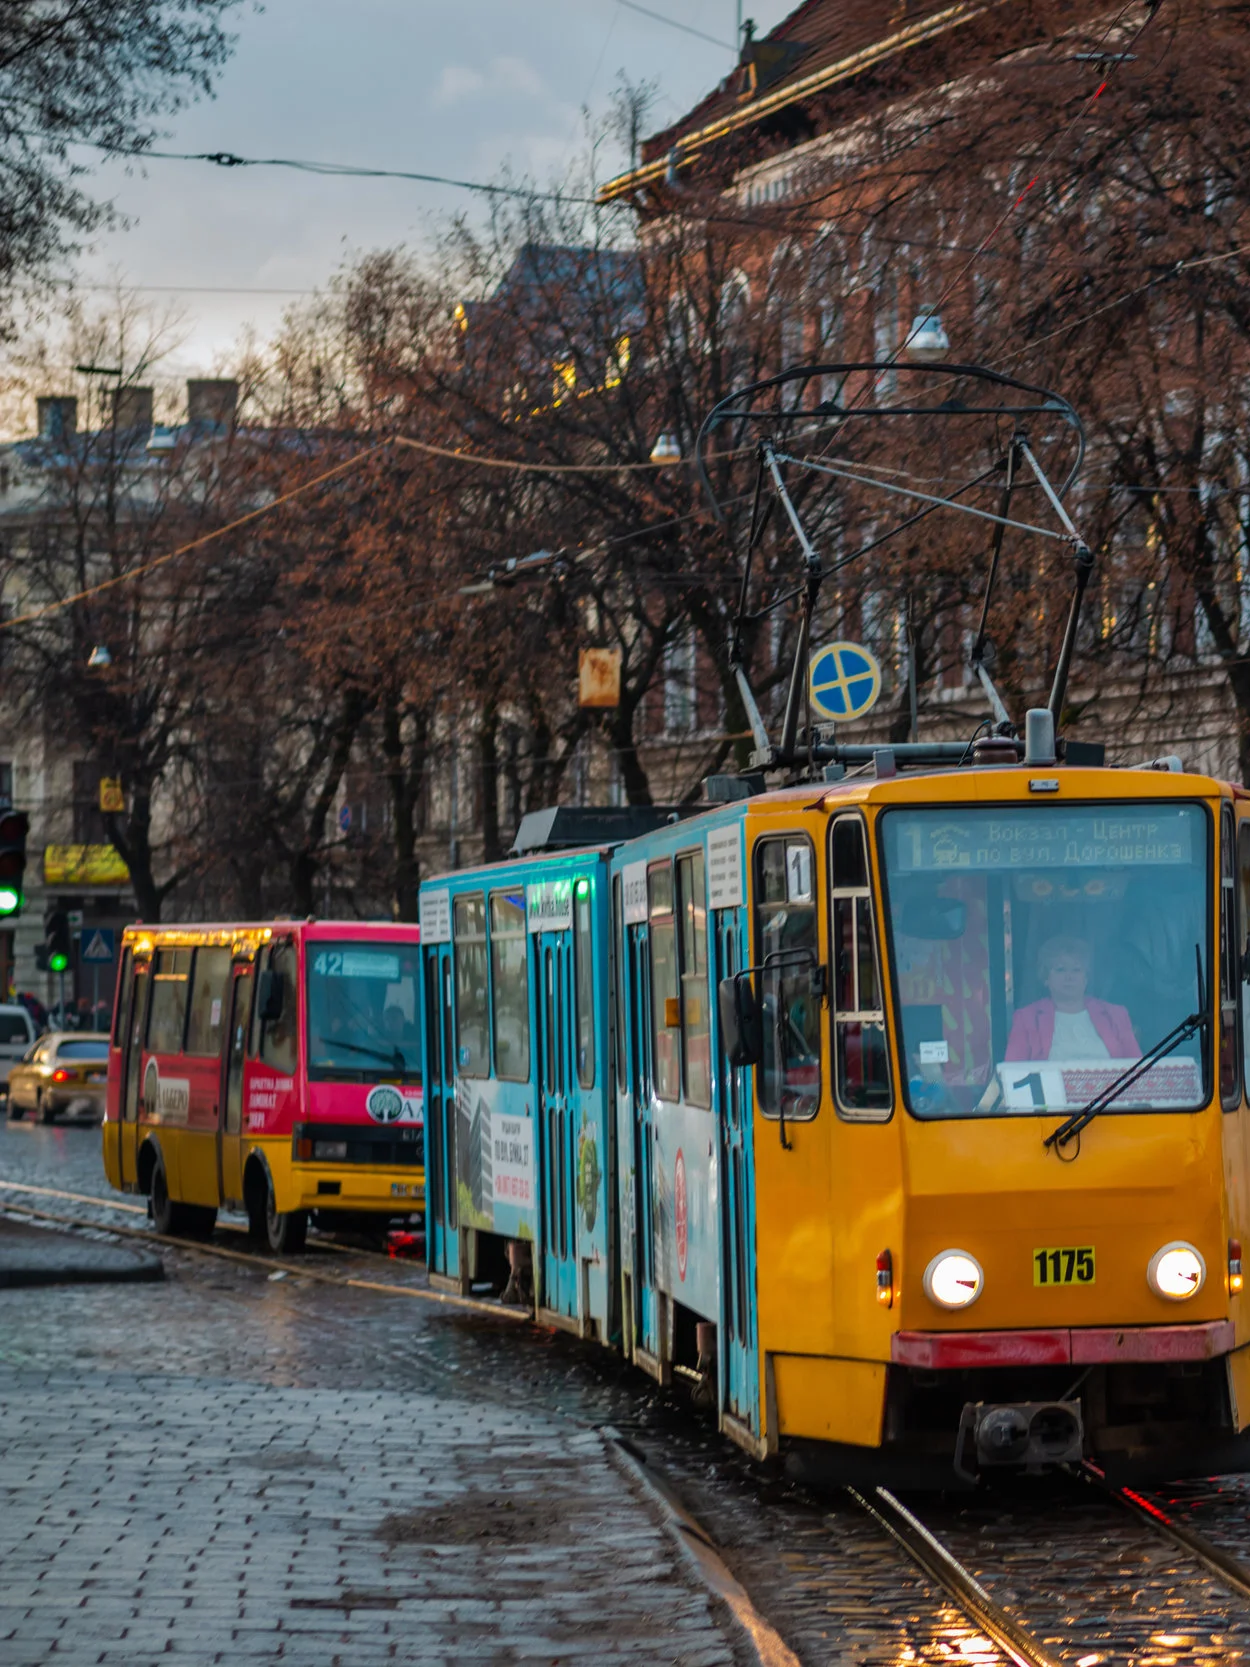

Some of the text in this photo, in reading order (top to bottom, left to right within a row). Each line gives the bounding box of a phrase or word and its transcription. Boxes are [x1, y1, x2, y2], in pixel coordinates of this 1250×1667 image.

[791, 851, 804, 896] 1
[314, 952, 342, 976] 42
[1012, 1072, 1047, 1106] 1
[1034, 1248, 1094, 1284] 1175
